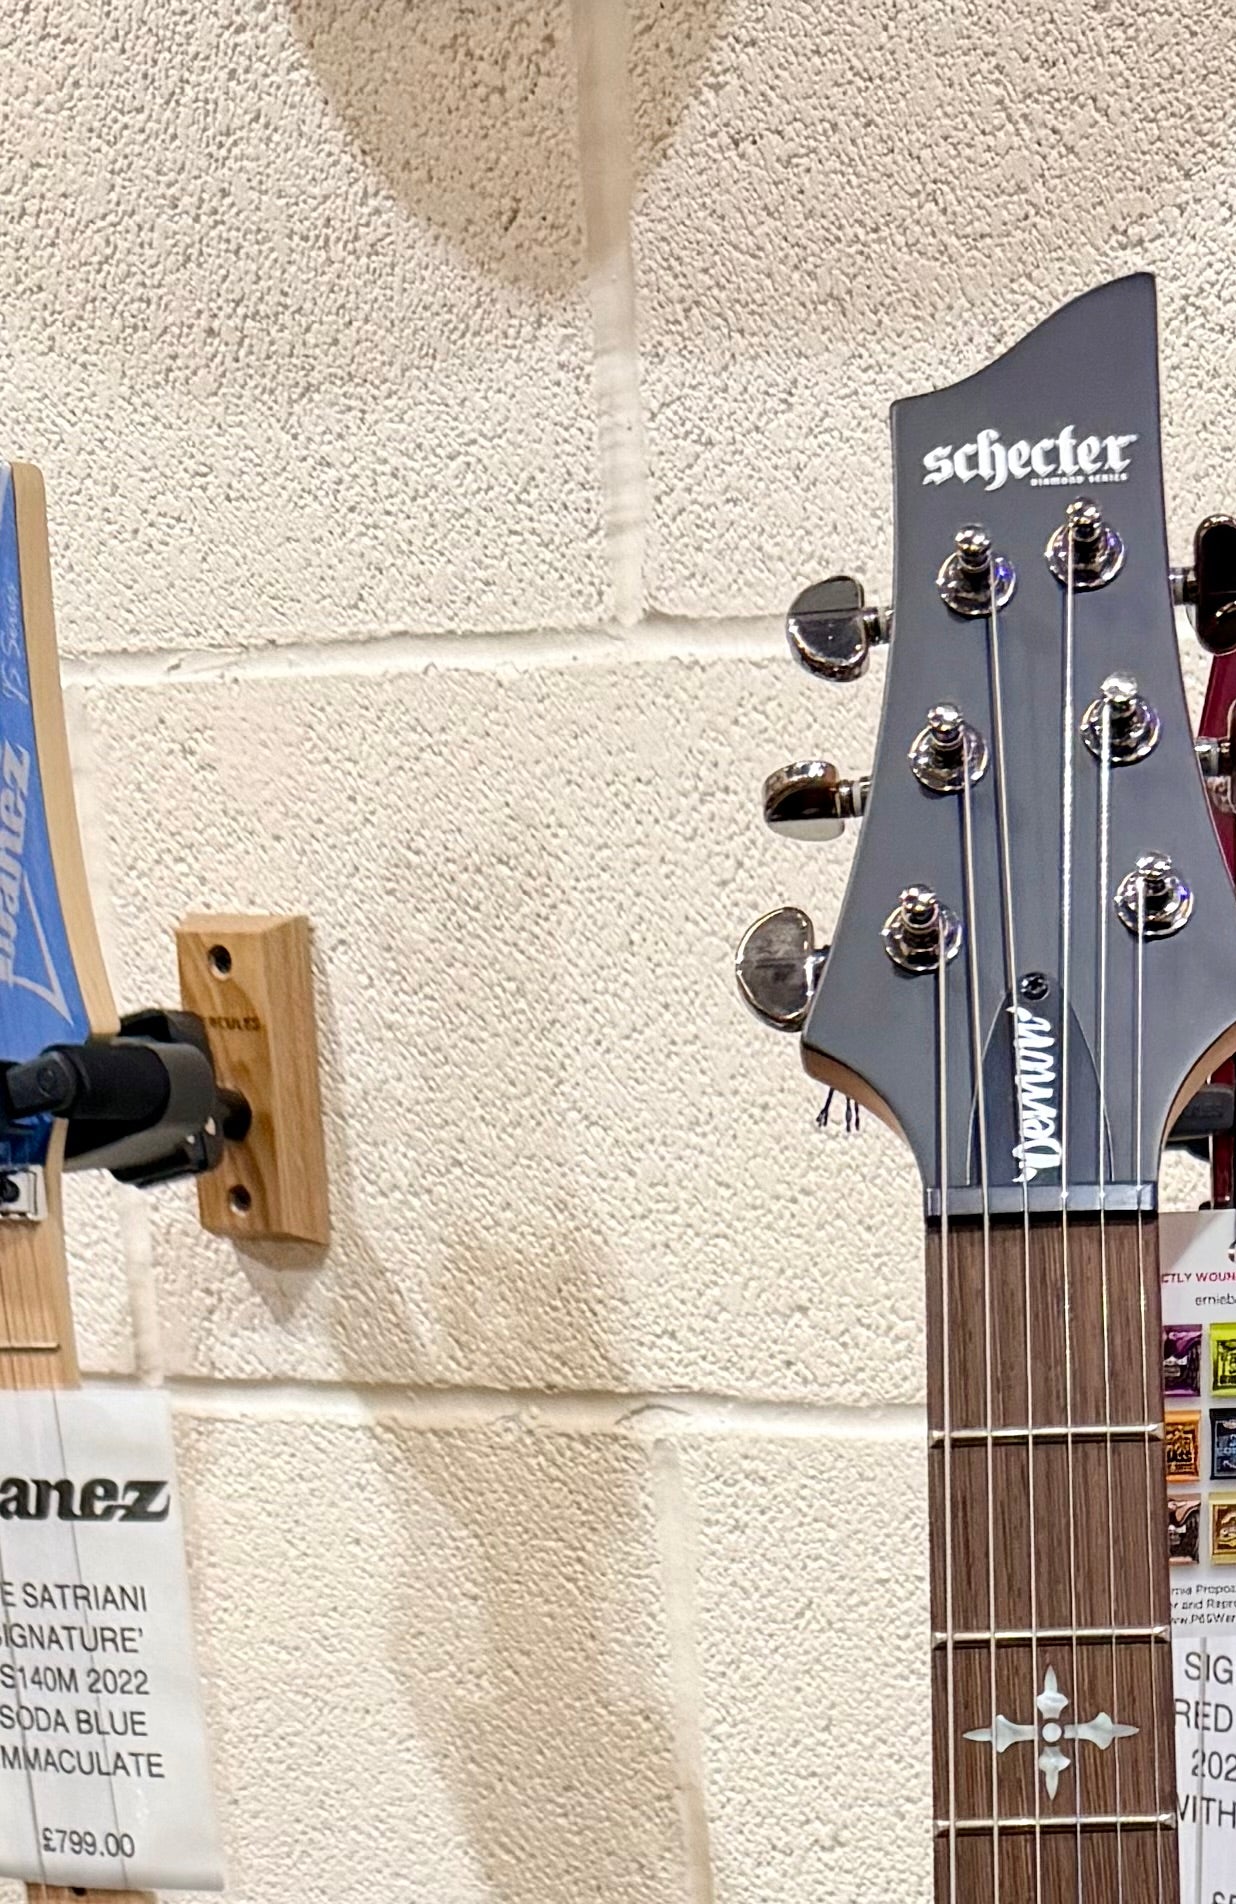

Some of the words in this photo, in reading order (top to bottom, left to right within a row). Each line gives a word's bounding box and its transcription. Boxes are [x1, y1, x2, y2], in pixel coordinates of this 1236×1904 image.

[922, 425, 1138, 491] schecter
[1005, 1006, 1062, 1182] Demon
[23, 1582, 148, 1613] SATRIANI
[0, 1623, 143, 1653] IGNATURE'
[87, 1668, 150, 1696] 2022
[0, 1704, 70, 1734] SODA
[76, 1709, 149, 1737] BLUE
[42, 1828, 135, 1858] £799.00
